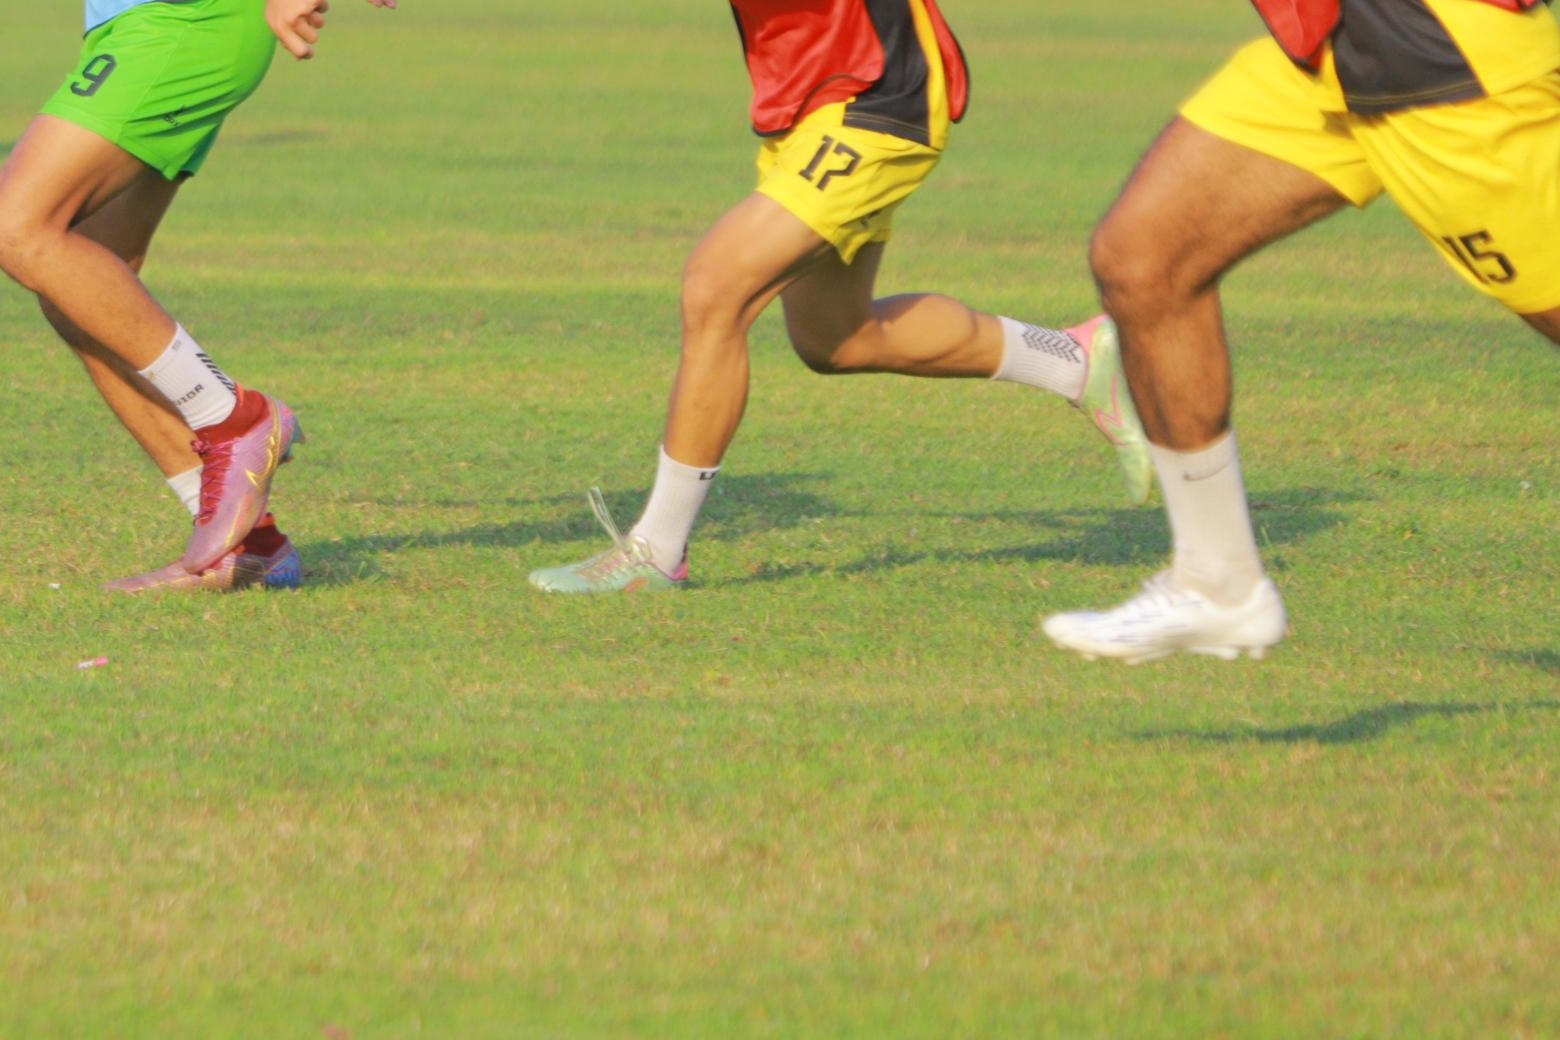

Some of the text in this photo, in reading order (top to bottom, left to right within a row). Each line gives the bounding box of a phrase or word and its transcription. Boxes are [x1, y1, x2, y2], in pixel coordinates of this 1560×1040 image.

[70, 54, 116, 96] 9
[799, 135, 862, 191] 17
[1441, 230, 1516, 285] 15
